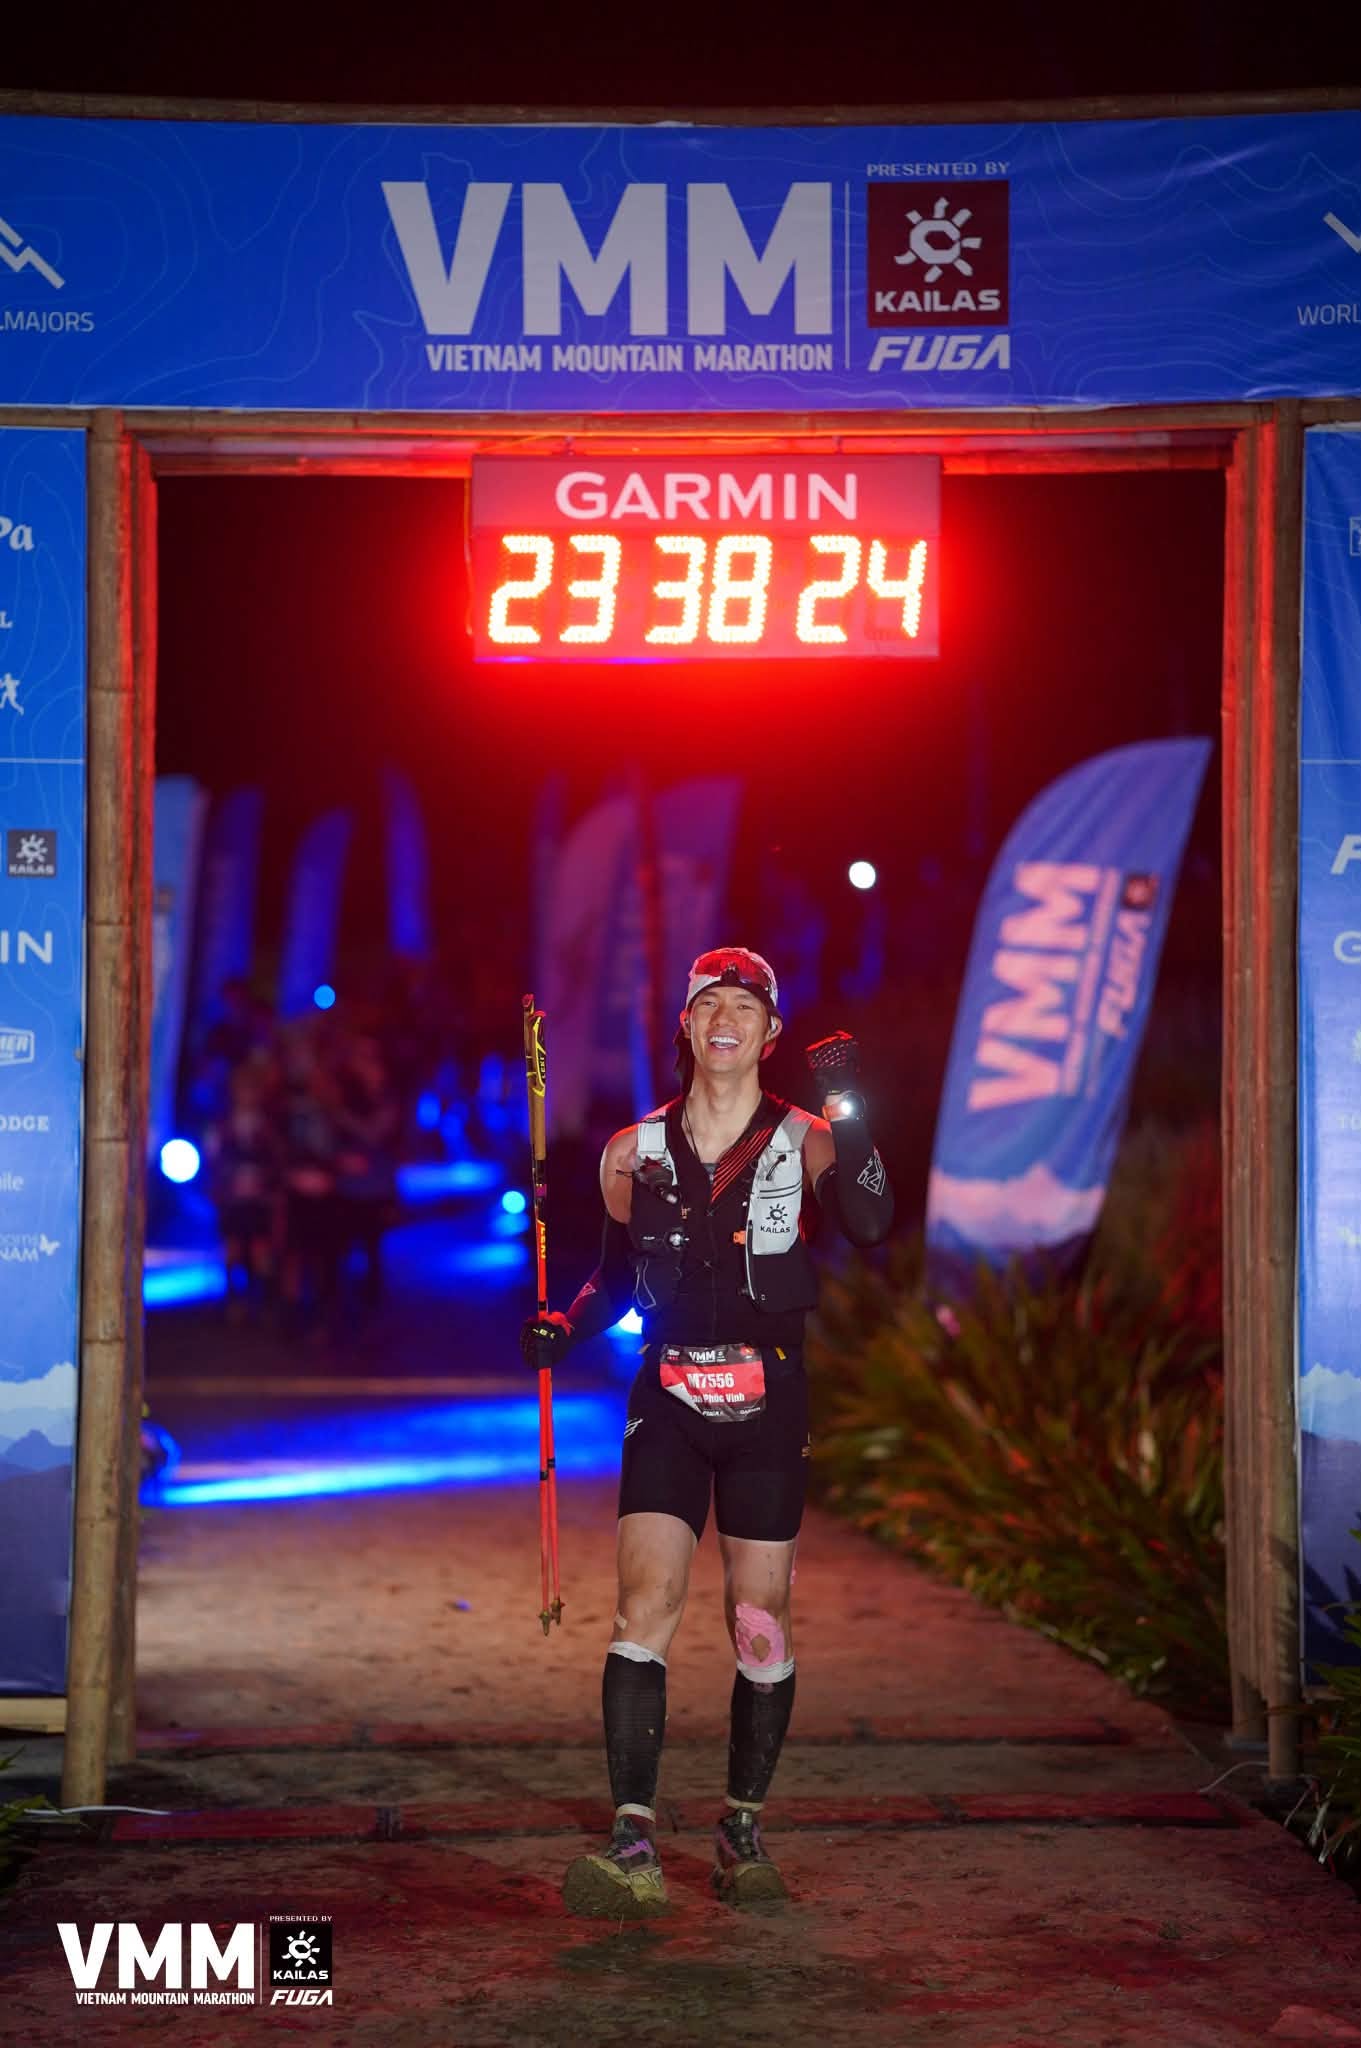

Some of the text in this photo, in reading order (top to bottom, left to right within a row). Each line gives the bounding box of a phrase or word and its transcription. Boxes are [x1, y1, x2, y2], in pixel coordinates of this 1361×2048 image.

[867, 162, 1010, 177] PRESENTED BY
[381, 181, 832, 336] VMM
[874, 289, 1001, 313] KAILAS
[427, 344, 833, 372] VIETNAM MOUNTAIN MARATHON
[869, 334, 1010, 372] FUGA
[555, 471, 858, 522] GARMIN
[488, 534, 928, 645] 23 38 24
[968, 862, 1101, 1112] VMM
[760, 1225, 790, 1233] KAILAS
[688, 1350, 716, 1361] VMM
[687, 1372, 735, 1389] M7556
